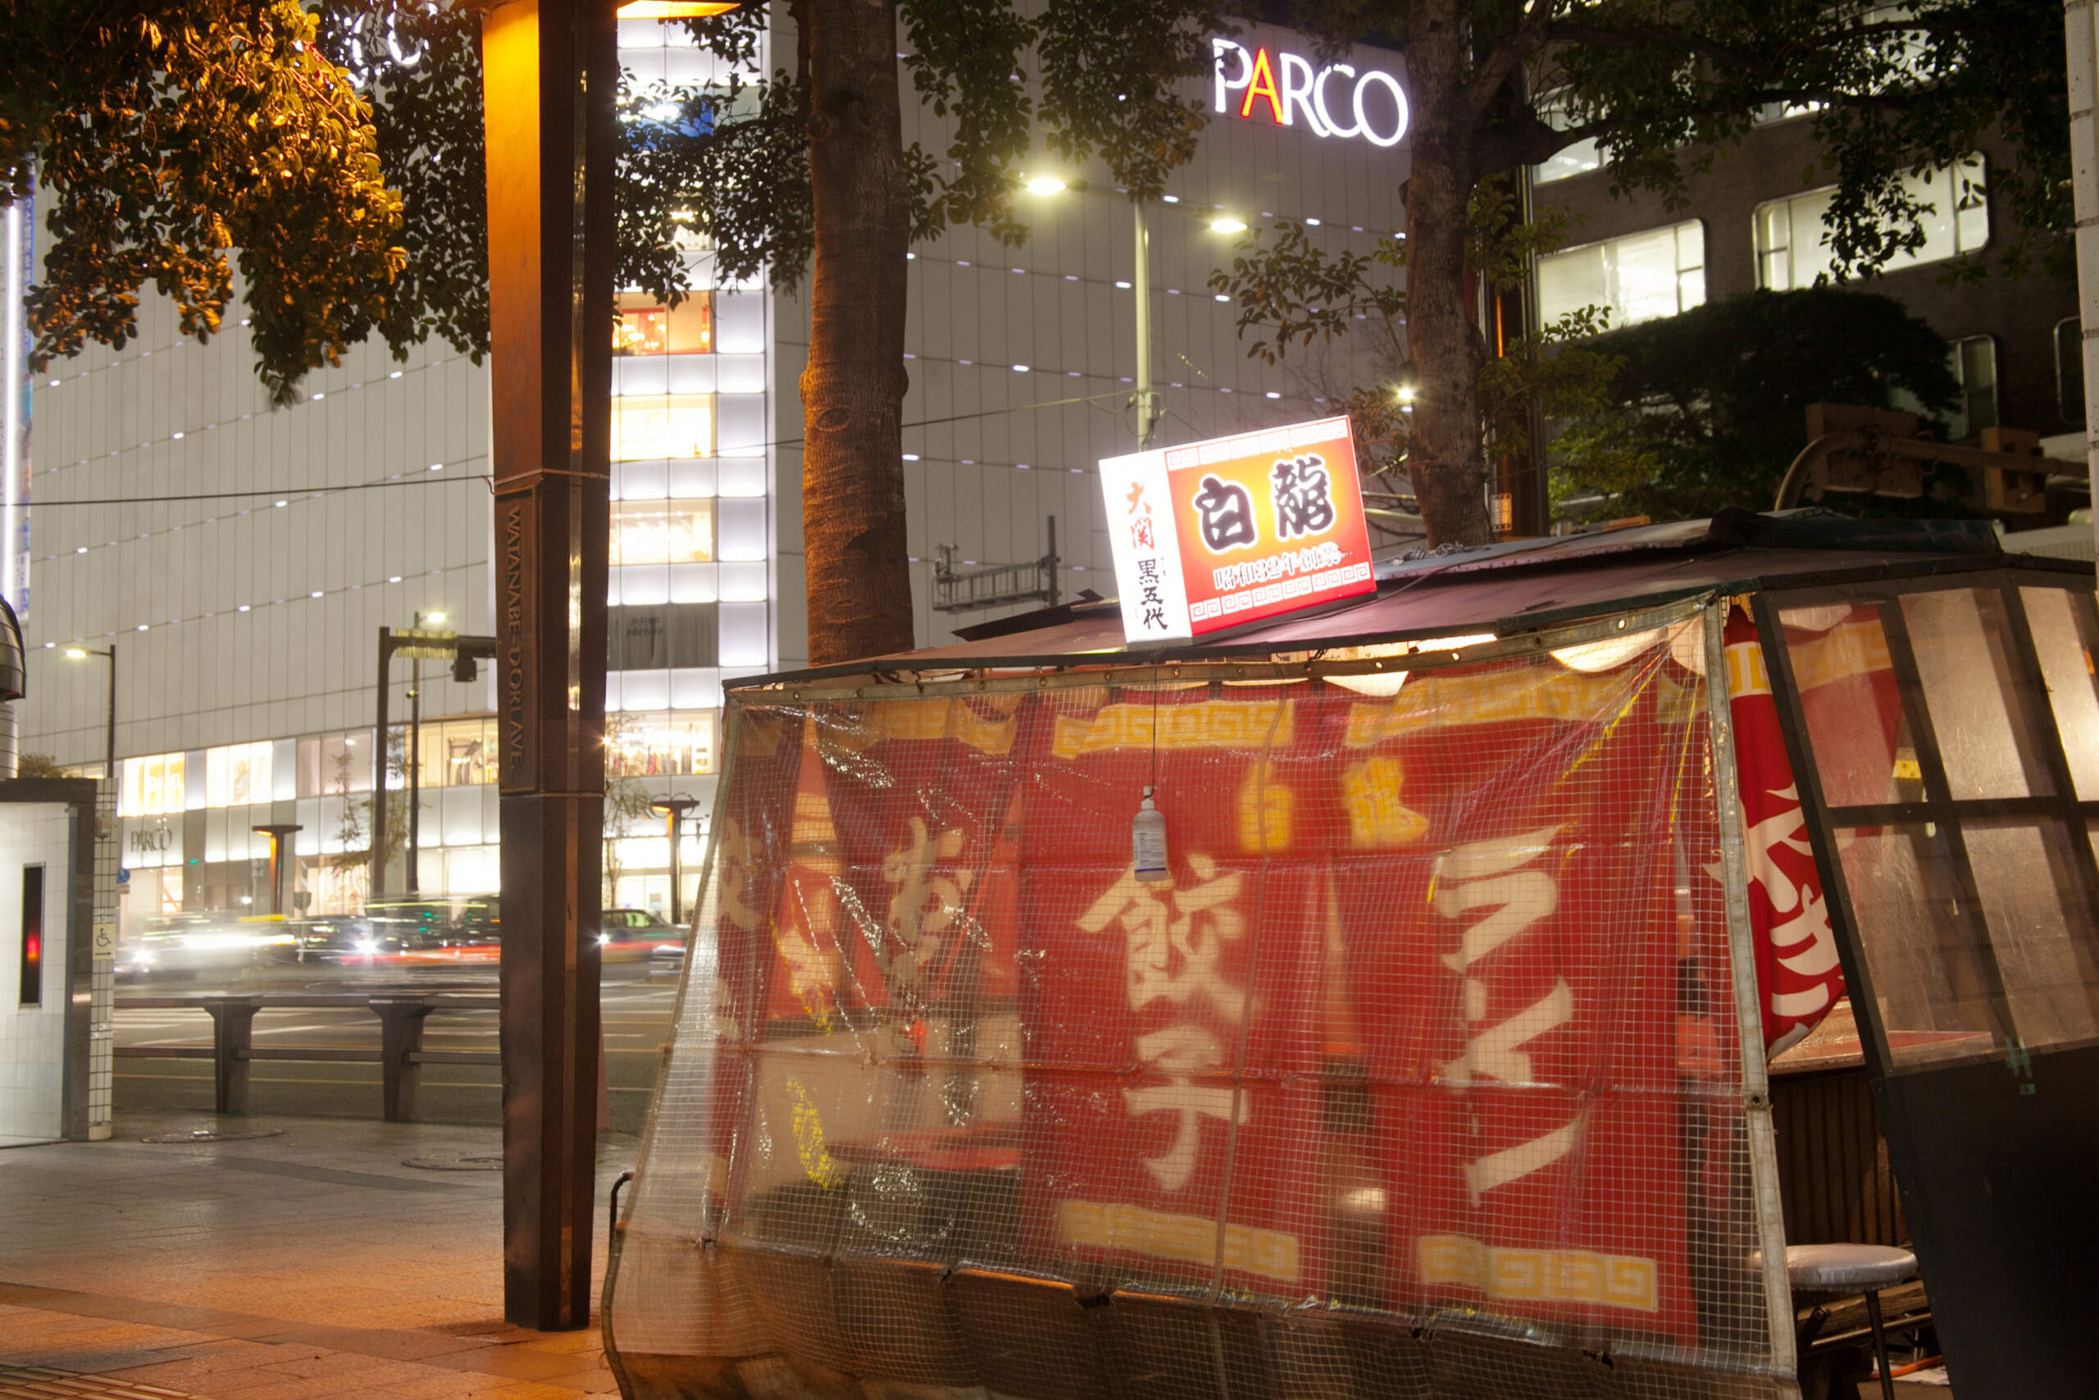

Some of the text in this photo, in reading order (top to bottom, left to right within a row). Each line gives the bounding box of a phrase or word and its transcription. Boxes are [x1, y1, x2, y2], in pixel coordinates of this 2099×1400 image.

[1212, 38, 1409, 147] PARCO
[1195, 456, 1334, 550] 白龍
[506, 506, 524, 713] WATANABE-DORI
[1137, 557, 1168, 630] 黒五代
[130, 828, 173, 852] PARCO
[1075, 852, 1256, 1192] 餃子
